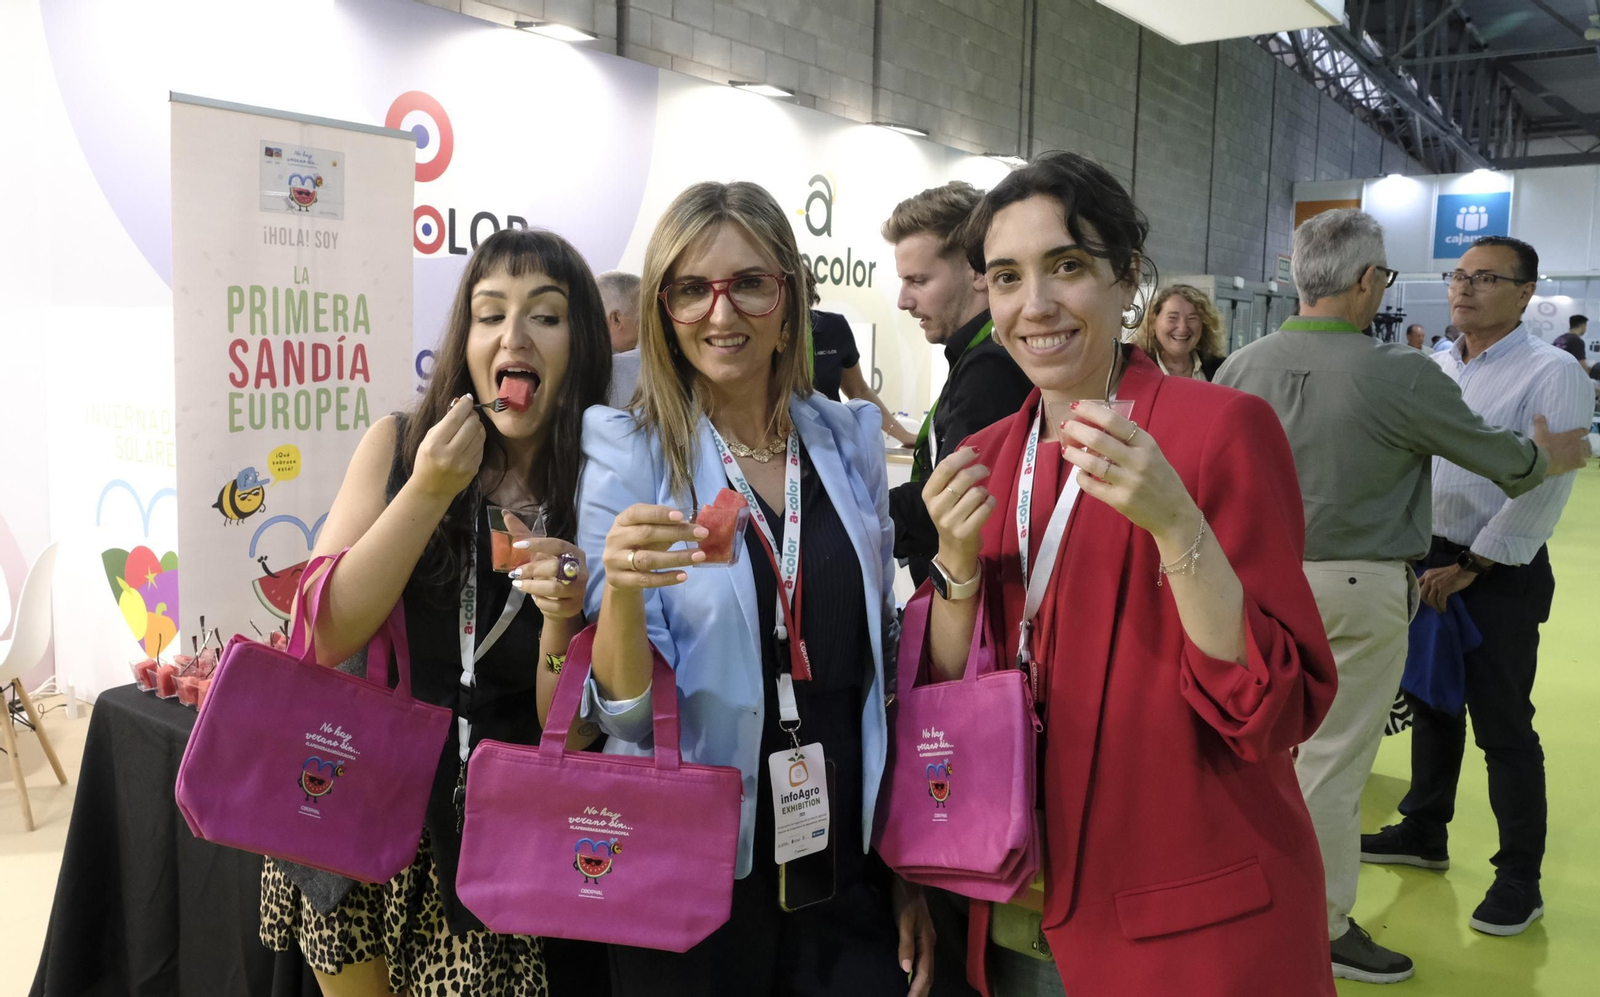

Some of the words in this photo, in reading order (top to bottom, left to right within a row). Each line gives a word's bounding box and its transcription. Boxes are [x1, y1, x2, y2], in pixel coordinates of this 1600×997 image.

[263, 225, 310, 247] ¡HOLA!
[315, 230, 339, 250] SOY
[294, 265, 310, 285] LA
[227, 284, 371, 336] PRIMERA
[228, 335, 371, 390] SANDÍA
[85, 401, 170, 435] INVERNAD
[228, 386, 371, 433] EUROPEA
[115, 435, 175, 467] SOLARE
[305, 732, 339, 747] verano
[320, 721, 333, 733] No
[334, 725, 353, 742] hay
[923, 728, 931, 739] No
[931, 727, 945, 741] hay
[780, 786, 820, 805] infoAgro
[781, 796, 821, 815] EXHIBITION
[568, 816, 607, 827] verano
[583, 806, 598, 816] No
[600, 807, 622, 820] hay
